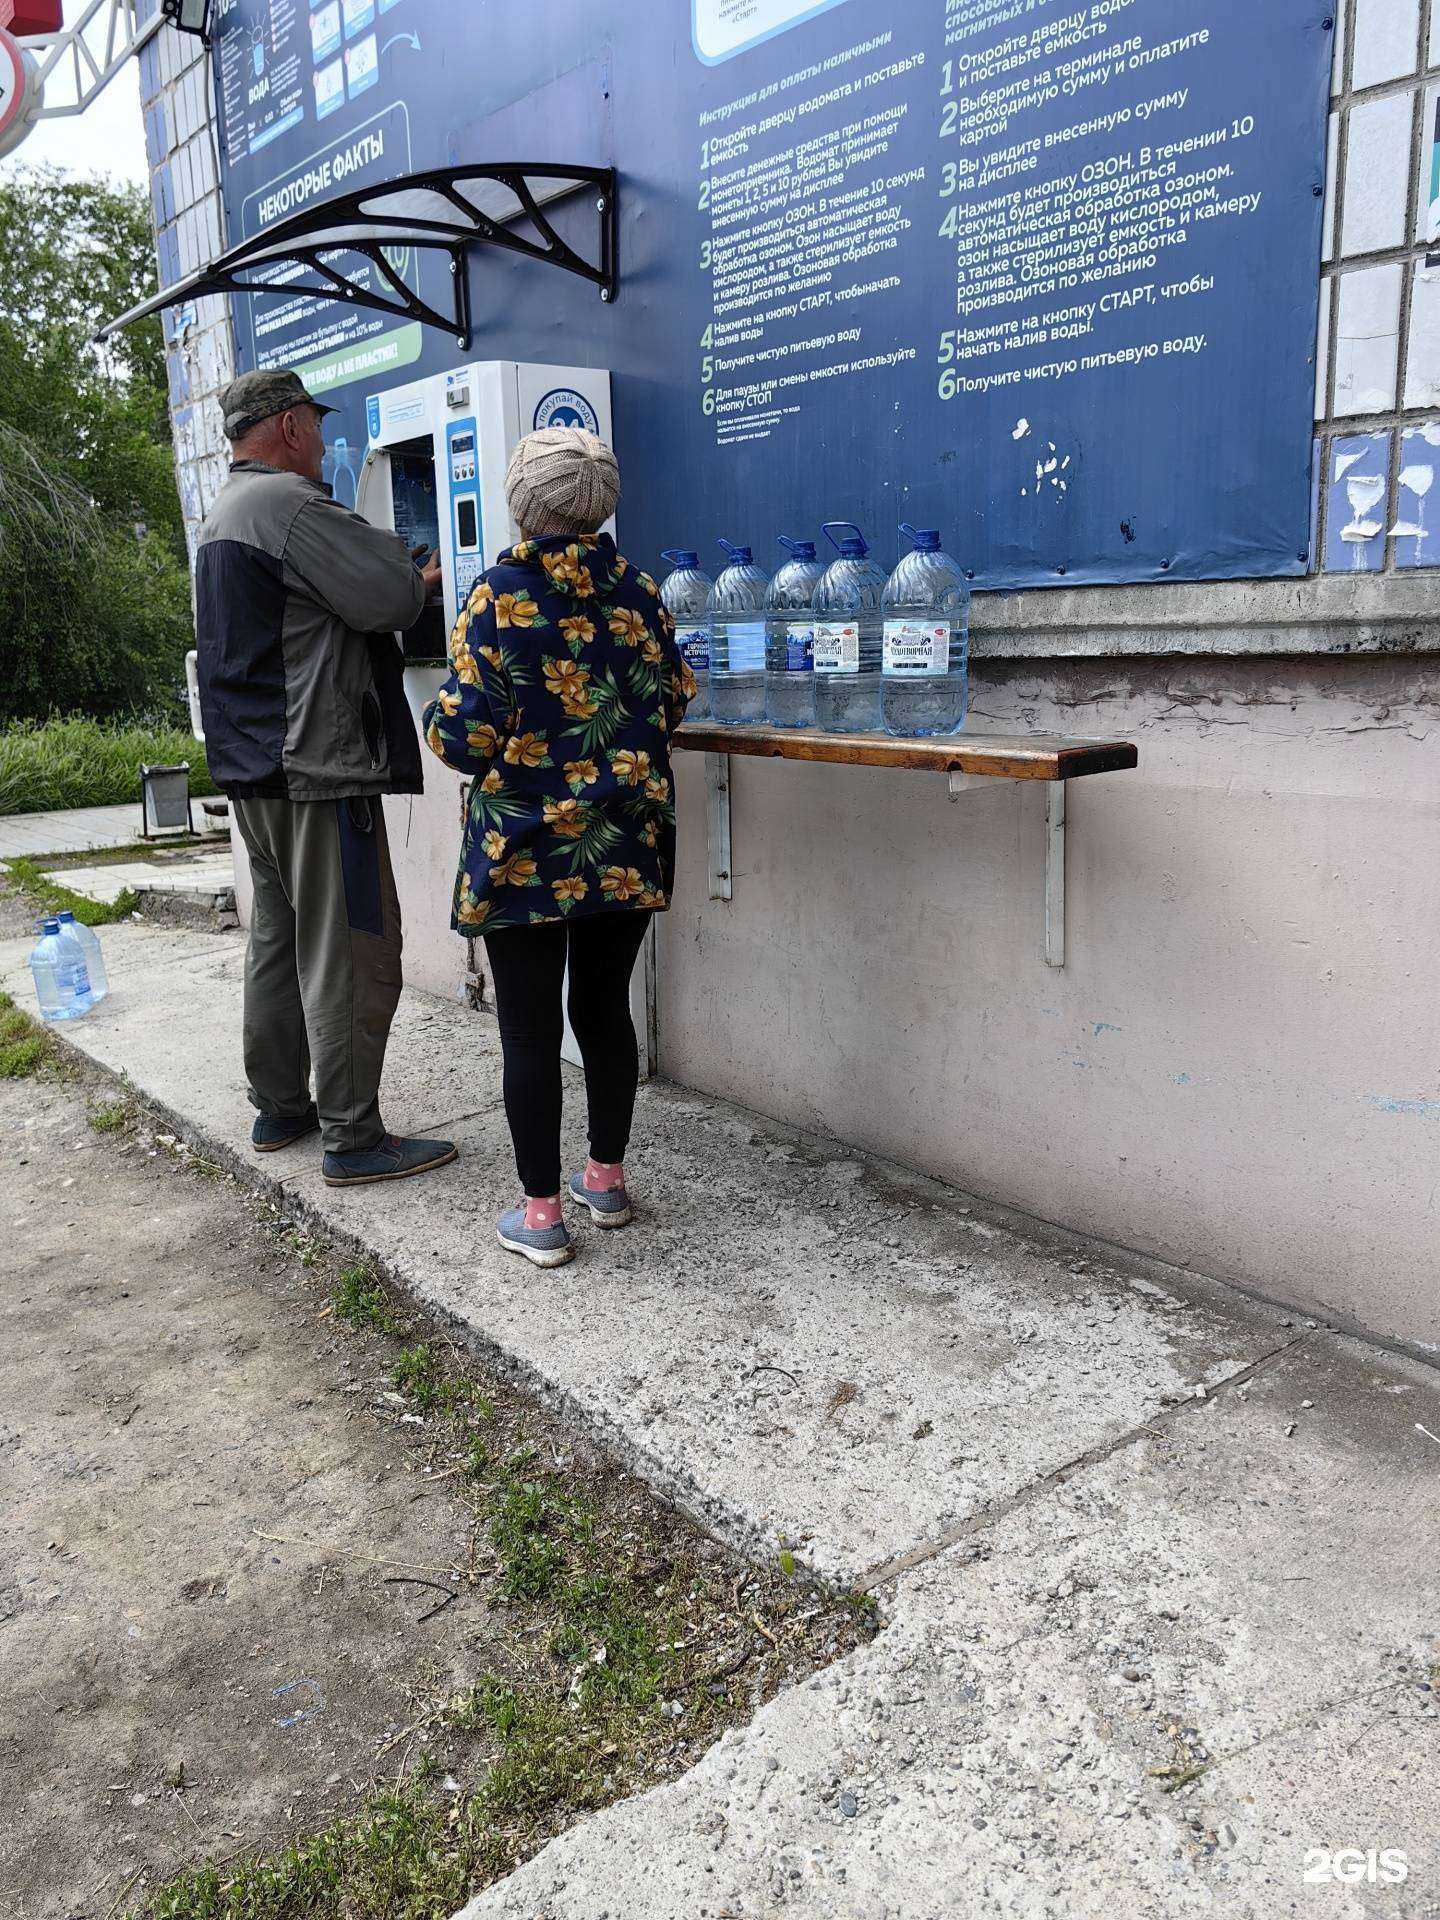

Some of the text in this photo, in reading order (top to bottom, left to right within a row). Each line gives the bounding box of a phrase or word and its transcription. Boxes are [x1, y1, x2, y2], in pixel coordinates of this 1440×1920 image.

[939, 62, 952, 93] 1
[959, 34, 1026, 72] Откройте
[1030, 9, 1086, 45] дверцу
[945, 1, 1022, 45] магнитных
[1026, 0, 1034, 11] и
[248, 77, 270, 105] ВОДА
[699, 31, 891, 126] Инструкция для оплаты наличными
[700, 52, 924, 168] 1 Откройте дверцу водомата и поставьте
[939, 34, 1141, 135] 2 Выберите на терминале
[960, 28, 1209, 130] необходимую сумму и оплатите
[698, 102, 907, 208] 2 Внесите денежные средства при помощи
[710, 141, 748, 165] емкость
[796, 144, 839, 169] Водомат
[841, 121, 897, 153] принимает
[939, 87, 1188, 195] 3 Вы увидите внесенную сумму
[959, 115, 1007, 146] картой
[258, 161, 331, 225] НЕКОТОРЫЕ
[332, 129, 384, 181] ФАКТЫ
[711, 195, 743, 216] монеты
[763, 183, 768, 196] 5
[770, 183, 775, 194] и
[778, 175, 788, 191] 10
[791, 161, 824, 189] рублей
[828, 158, 842, 172] Вы
[845, 140, 888, 169] увидите
[712, 172, 843, 228] внесенную сумму на дисплее
[938, 114, 1253, 240] 4 Нажмите кнопку ОЗОН. В течении 10
[700, 241, 710, 267] 3
[712, 227, 749, 248] Нажмите
[752, 216, 783, 235] кнопку
[820, 198, 825, 212] В
[828, 186, 868, 209] течение
[871, 178, 883, 194] 10
[886, 167, 924, 189] секунд
[712, 194, 886, 263] будет производиться автоматическая
[713, 252, 756, 275] обработка
[796, 231, 820, 248] Озон
[823, 214, 872, 239] насыщает
[875, 205, 901, 222] воду
[769, 260, 774, 270] а
[776, 251, 803, 268] также
[805, 231, 865, 259] стерилизует
[868, 217, 910, 239] емкость
[713, 291, 718, 301] и
[720, 282, 750, 299] камеру
[793, 254, 839, 277] Озоновая
[842, 236, 897, 262] обработка
[713, 271, 831, 315] производится по желанию
[700, 325, 712, 349] 4
[714, 316, 751, 334] Нажмите
[753, 313, 763, 323] на
[766, 303, 796, 320] кнопку
[714, 326, 763, 347] налив воды
[937, 273, 1213, 362] 5 Нажмите на кнопку СТАРТ, чтобы
[701, 327, 861, 381] 5 Получите чистую питьевую воду
[702, 347, 915, 414] 6 Для паузы или смены емкости используйте
[938, 333, 1207, 398] 6 Получите чистую питьевую воду.
[539, 394, 573, 422] покупай
[576, 400, 594, 425] воду
[716, 391, 771, 412] кнопку СТОП
